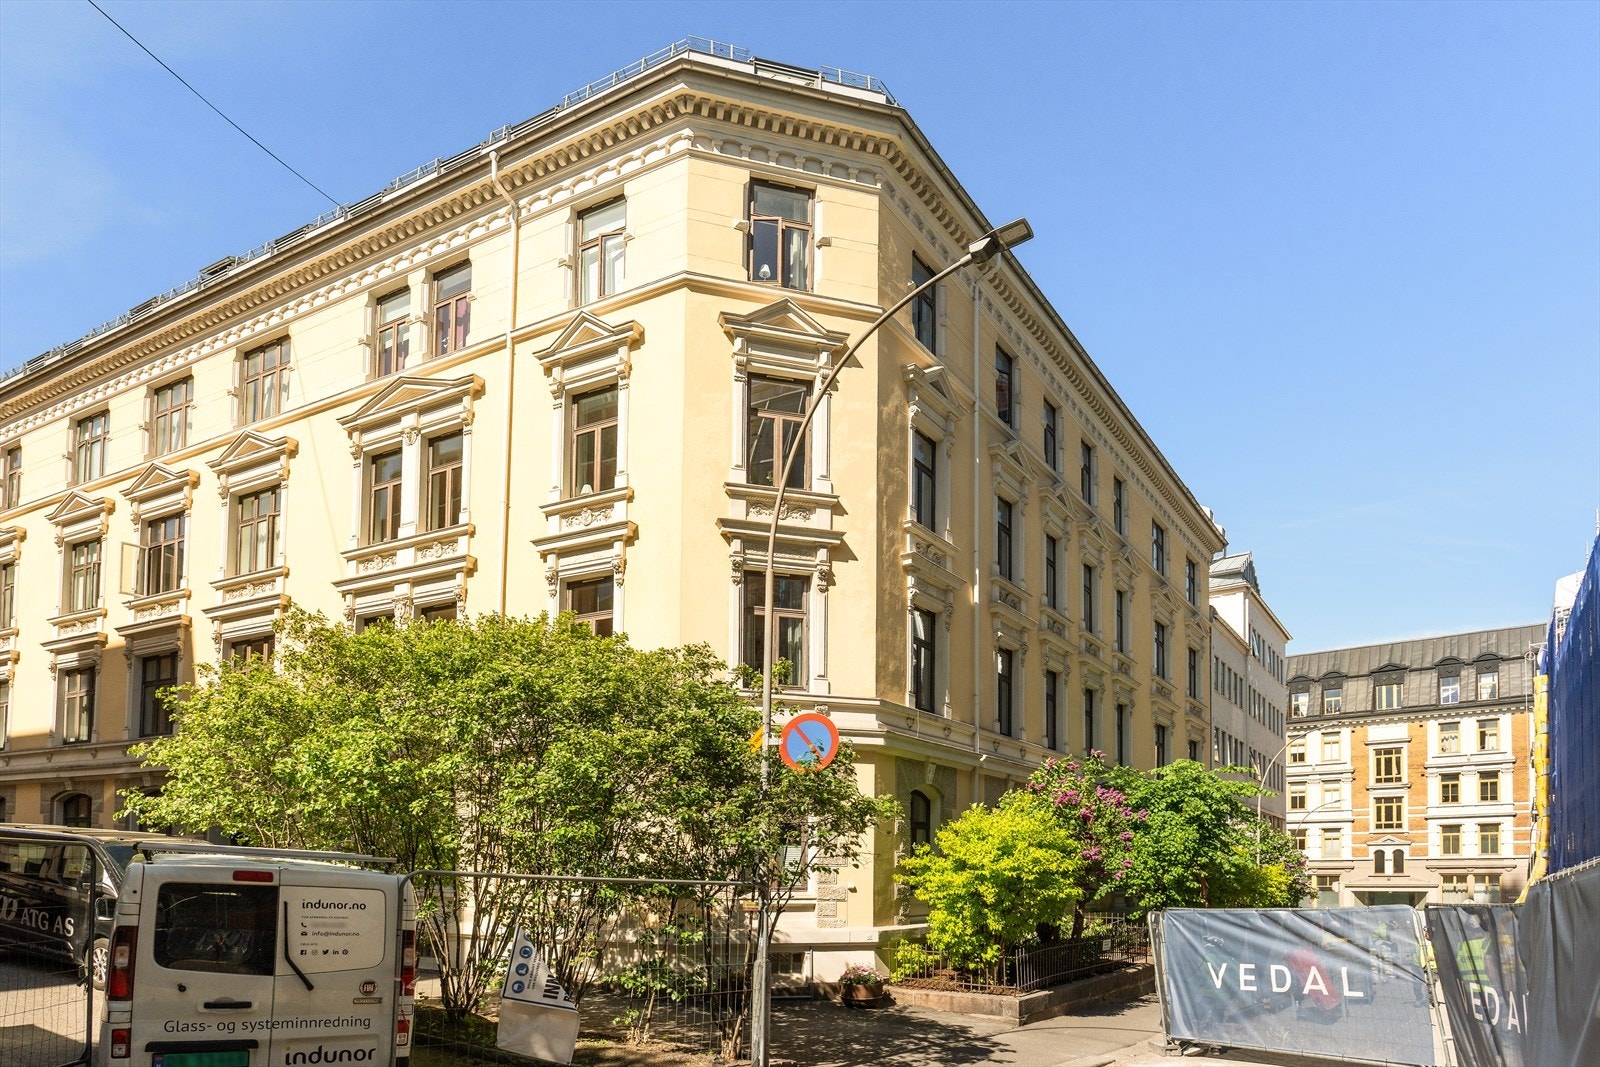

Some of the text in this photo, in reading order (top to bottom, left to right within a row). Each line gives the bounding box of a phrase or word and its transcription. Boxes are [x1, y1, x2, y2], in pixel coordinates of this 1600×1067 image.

[302, 899, 367, 910] indunor.no
[20, 907, 49, 931] ATG
[52, 915, 74, 937] AS
[1207, 962, 1364, 998] VEDAL
[164, 1016, 371, 1034] Glass- og systeminnredning
[285, 1045, 376, 1066] indunor
